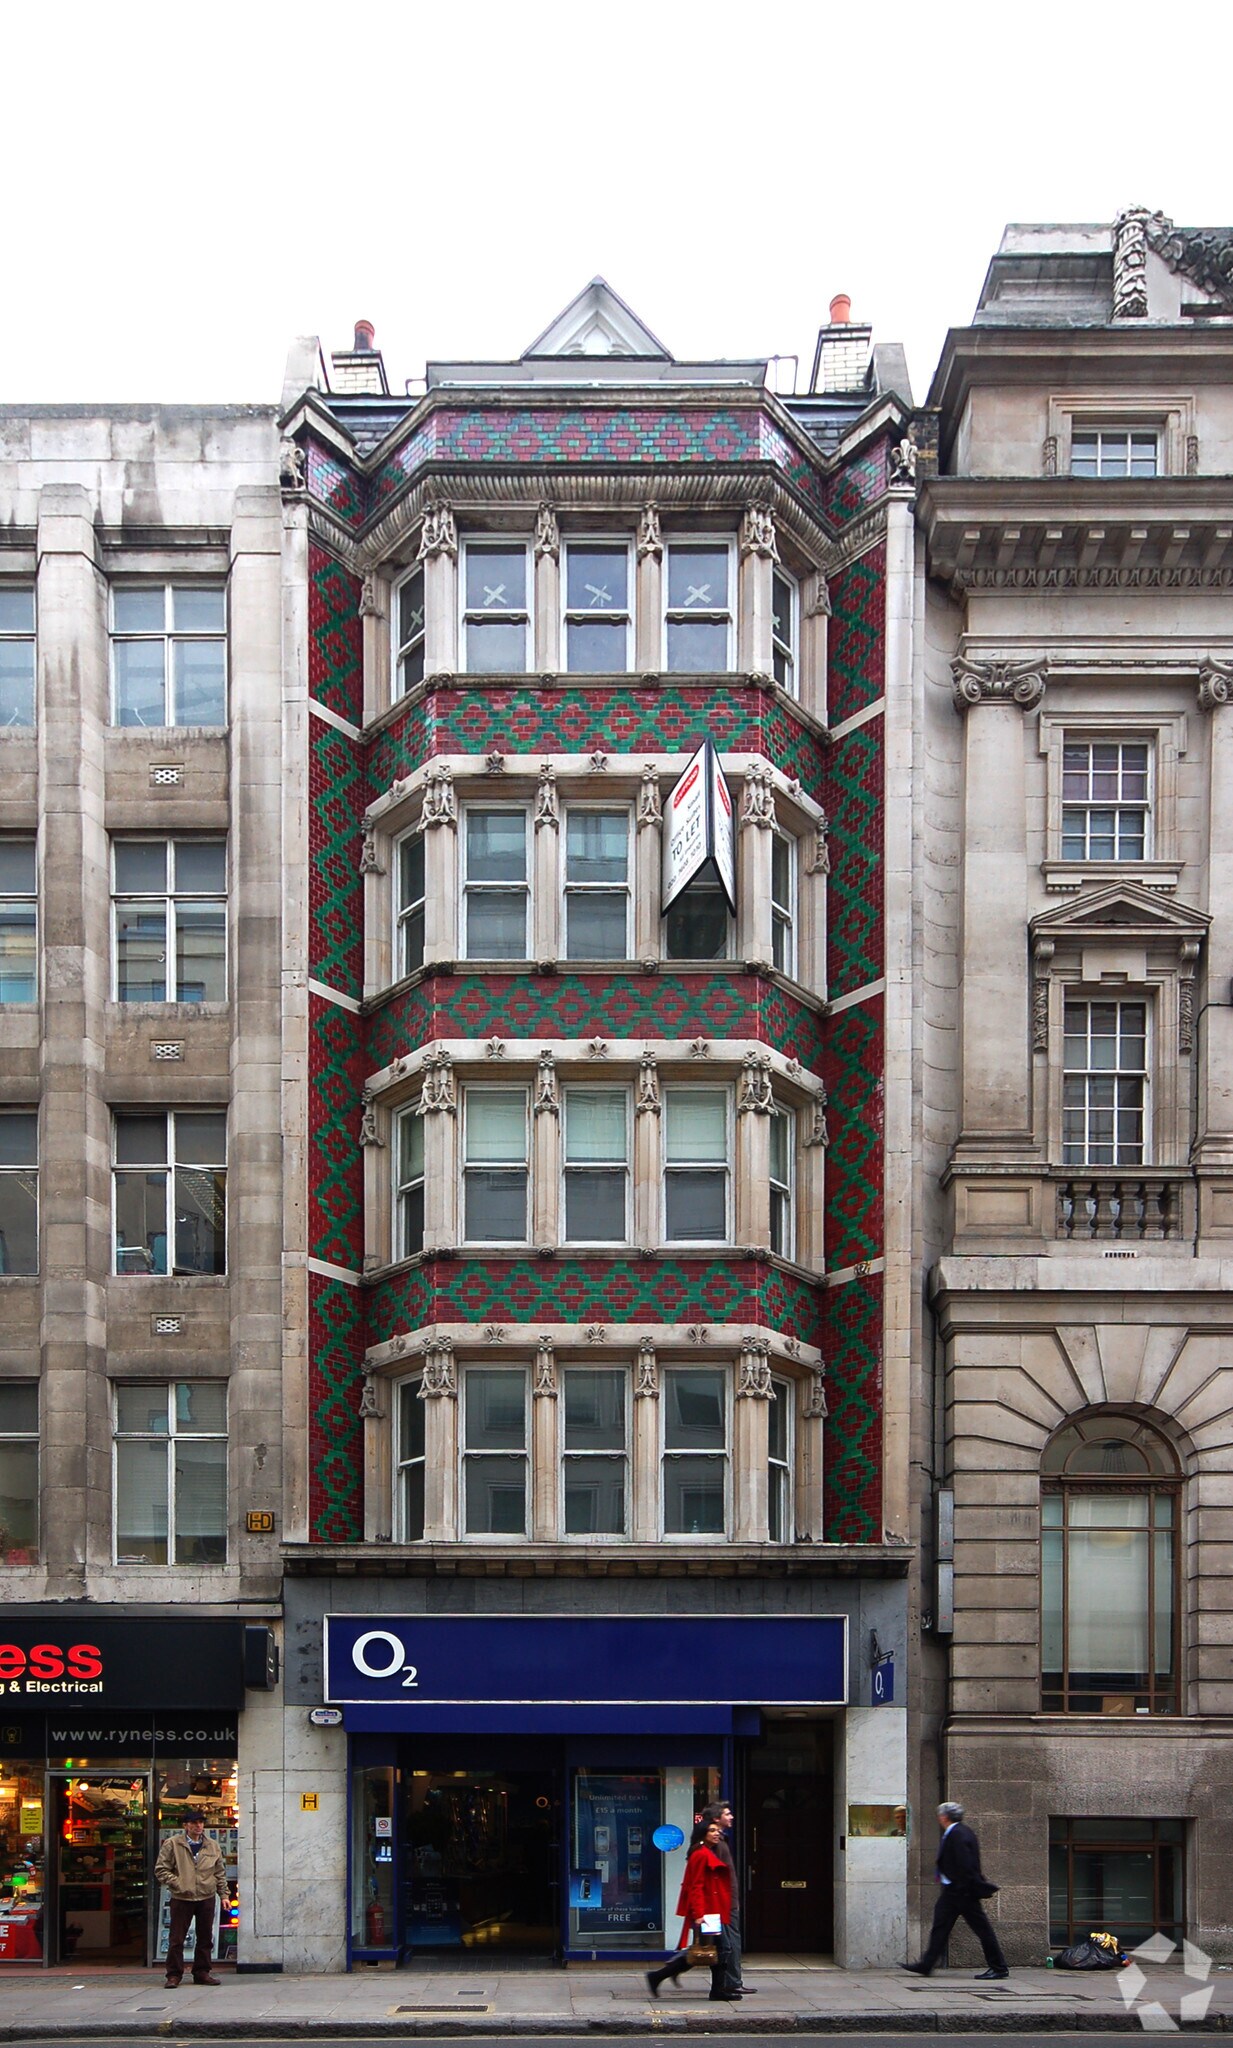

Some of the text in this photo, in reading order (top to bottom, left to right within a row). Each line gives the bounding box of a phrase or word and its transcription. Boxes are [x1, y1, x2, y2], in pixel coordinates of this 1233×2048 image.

[671, 840, 683, 861] TO
[685, 814, 700, 842] LET
[352, 1631, 418, 1687] O2
[9, 1680, 20, 1693] &
[26, 1680, 103, 1693] Electrical
[875, 1671, 884, 1698] O2
[52, 1728, 235, 1743] www.ryness.co.uk
[303, 1794, 317, 1809] H
[607, 1913, 631, 1922] FREE
